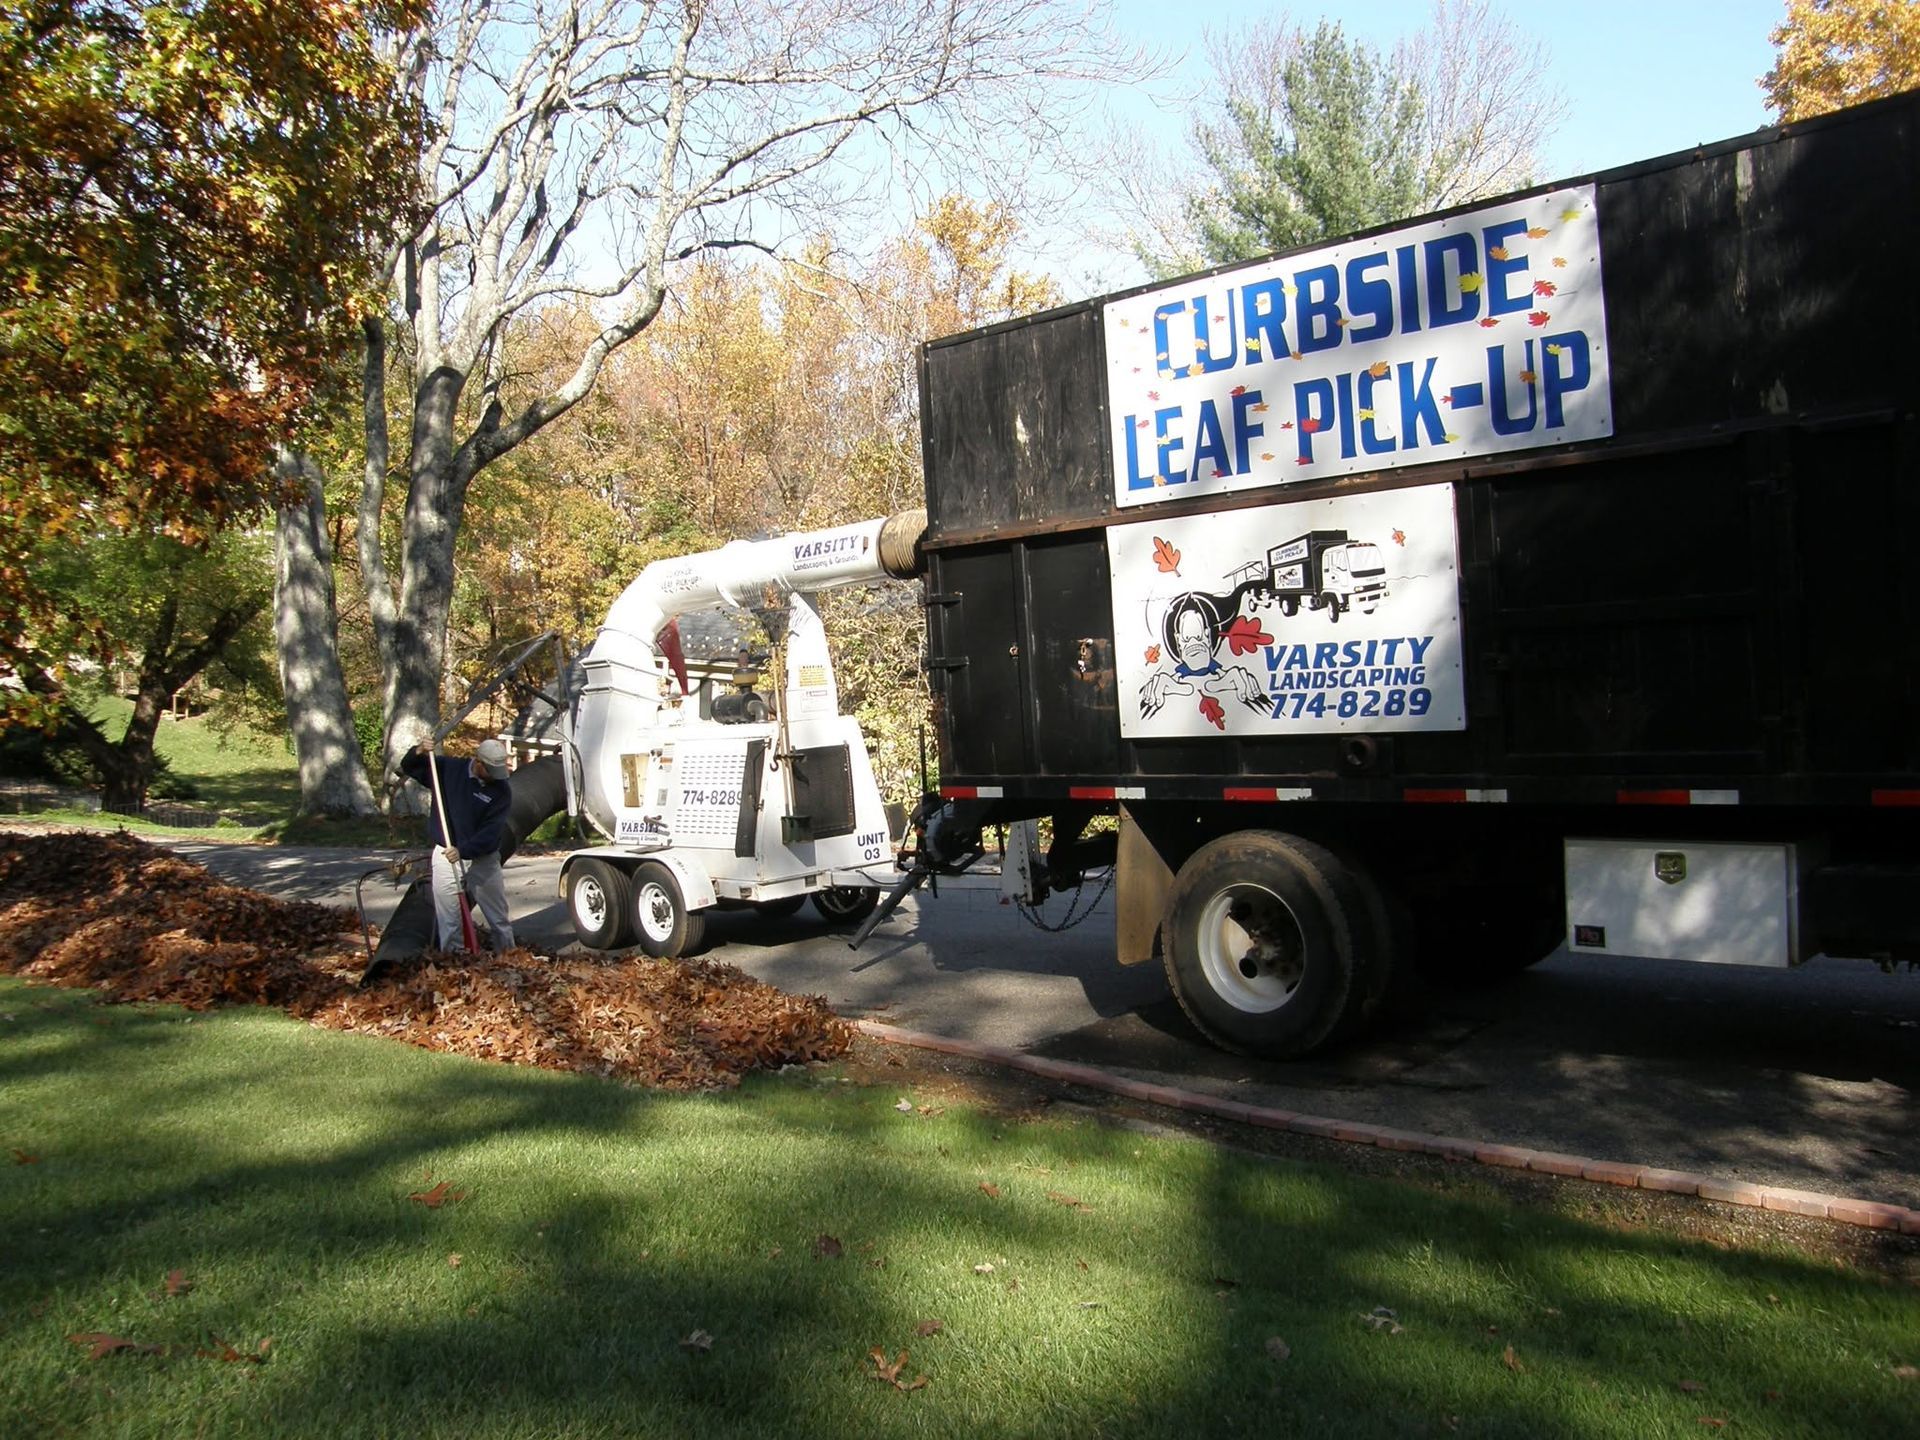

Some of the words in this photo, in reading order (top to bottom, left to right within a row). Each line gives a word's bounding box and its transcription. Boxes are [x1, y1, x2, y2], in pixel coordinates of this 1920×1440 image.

[1153, 218, 1534, 379] CURBSIDE
[1124, 390, 1265, 491] LEAF
[1292, 330, 1592, 464] PICK-UP
[794, 535, 859, 559] VARSITY
[1264, 636, 1433, 671] VARSITY
[1269, 666, 1425, 691] LANDSCAPING
[1270, 688, 1432, 720] 774-8289
[857, 832, 885, 847] UNIT
[864, 847, 880, 861] 03
